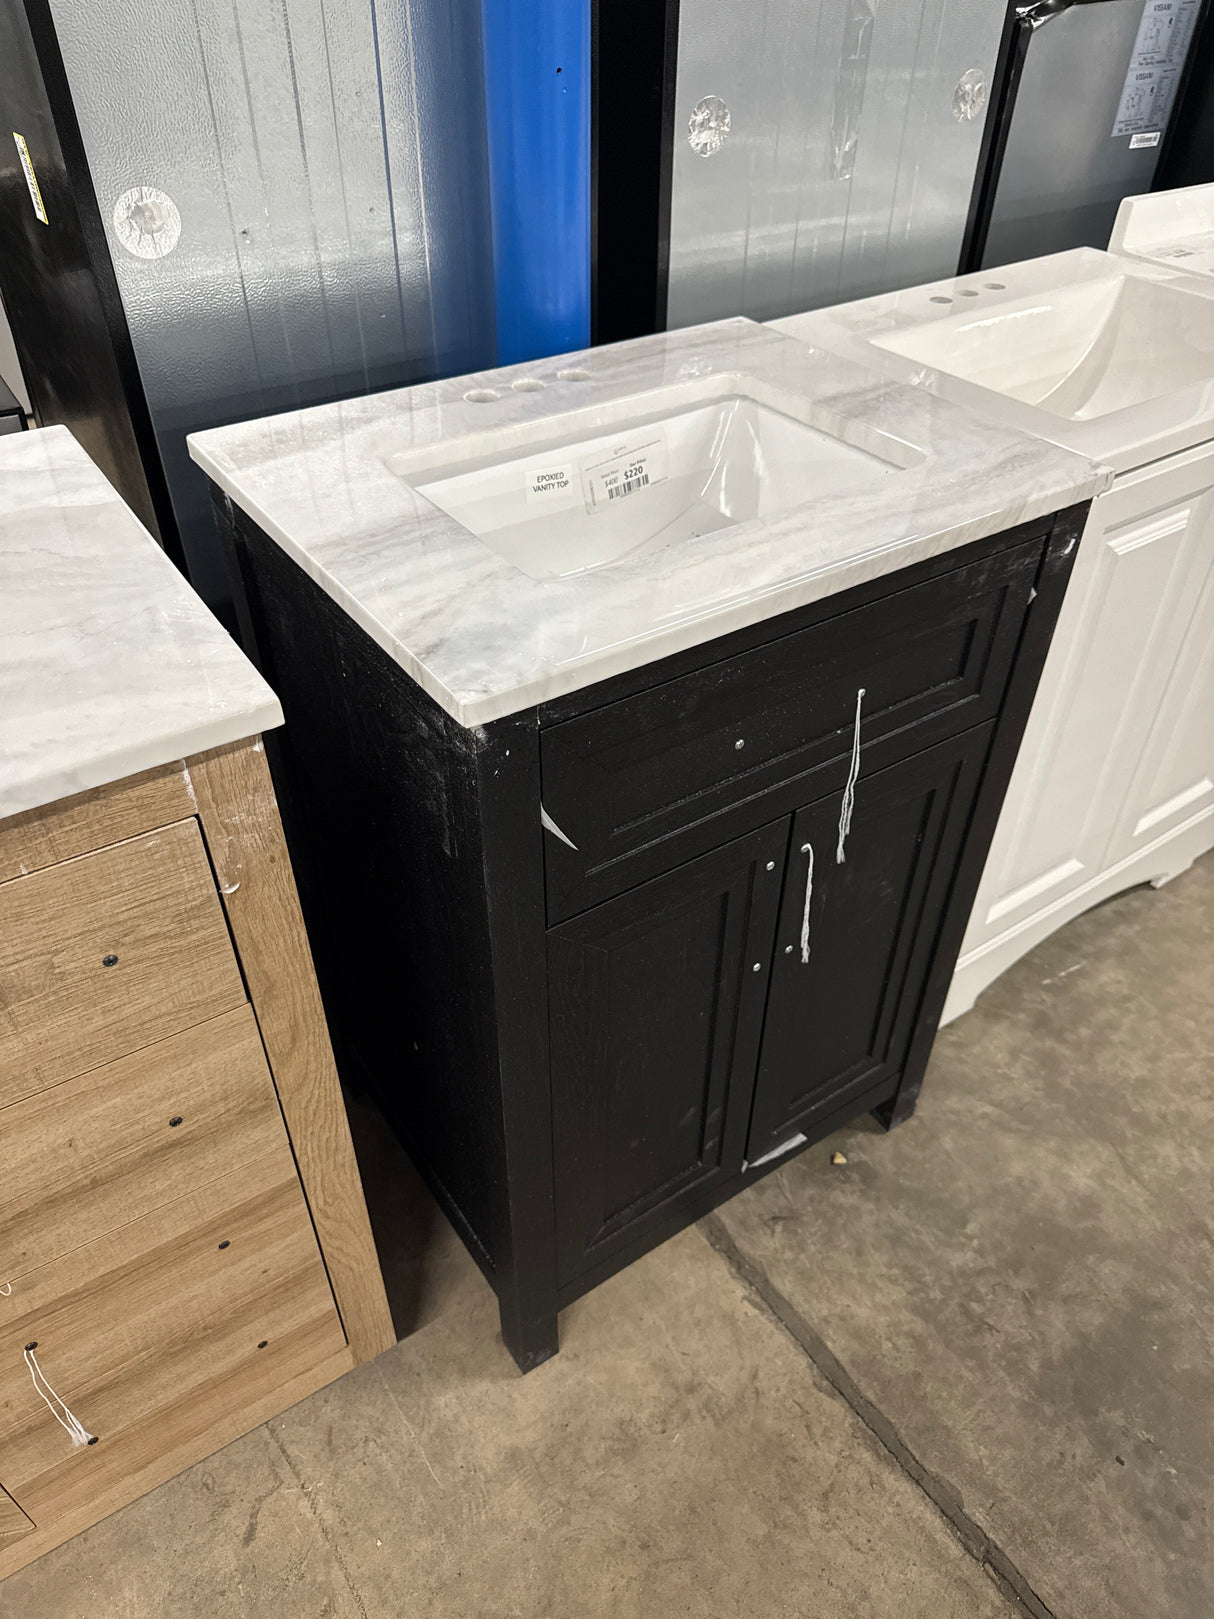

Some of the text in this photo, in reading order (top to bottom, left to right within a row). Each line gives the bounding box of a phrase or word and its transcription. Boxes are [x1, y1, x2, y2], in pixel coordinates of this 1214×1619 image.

[537, 472, 565, 483] EPOXIED
[624, 465, 643, 480] $220
[532, 480, 569, 493] VANITY TOP
[604, 476, 619, 488] $400
